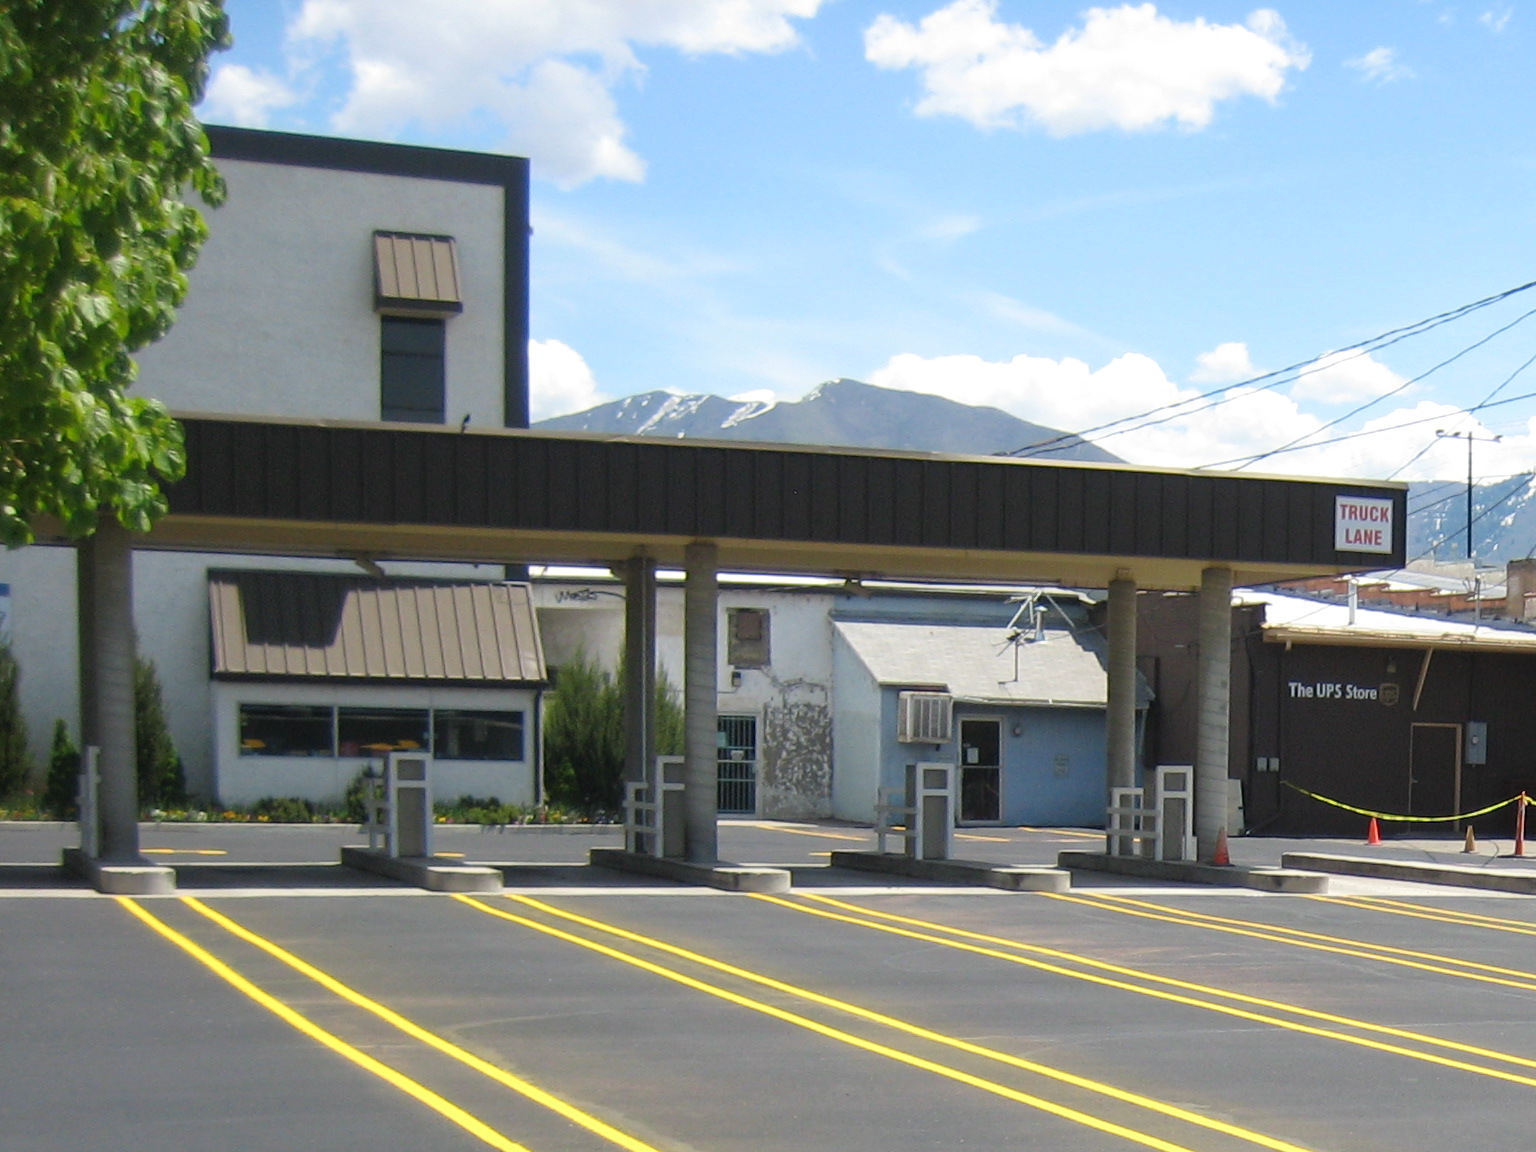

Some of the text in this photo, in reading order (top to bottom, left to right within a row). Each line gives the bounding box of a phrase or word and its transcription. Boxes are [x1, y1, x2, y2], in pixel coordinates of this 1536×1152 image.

[1340, 504, 1389, 522] TRUCK
[1345, 528, 1382, 545] LANE
[1288, 682, 1314, 698] The
[1316, 682, 1342, 699] UPS
[1345, 684, 1377, 700] Store
